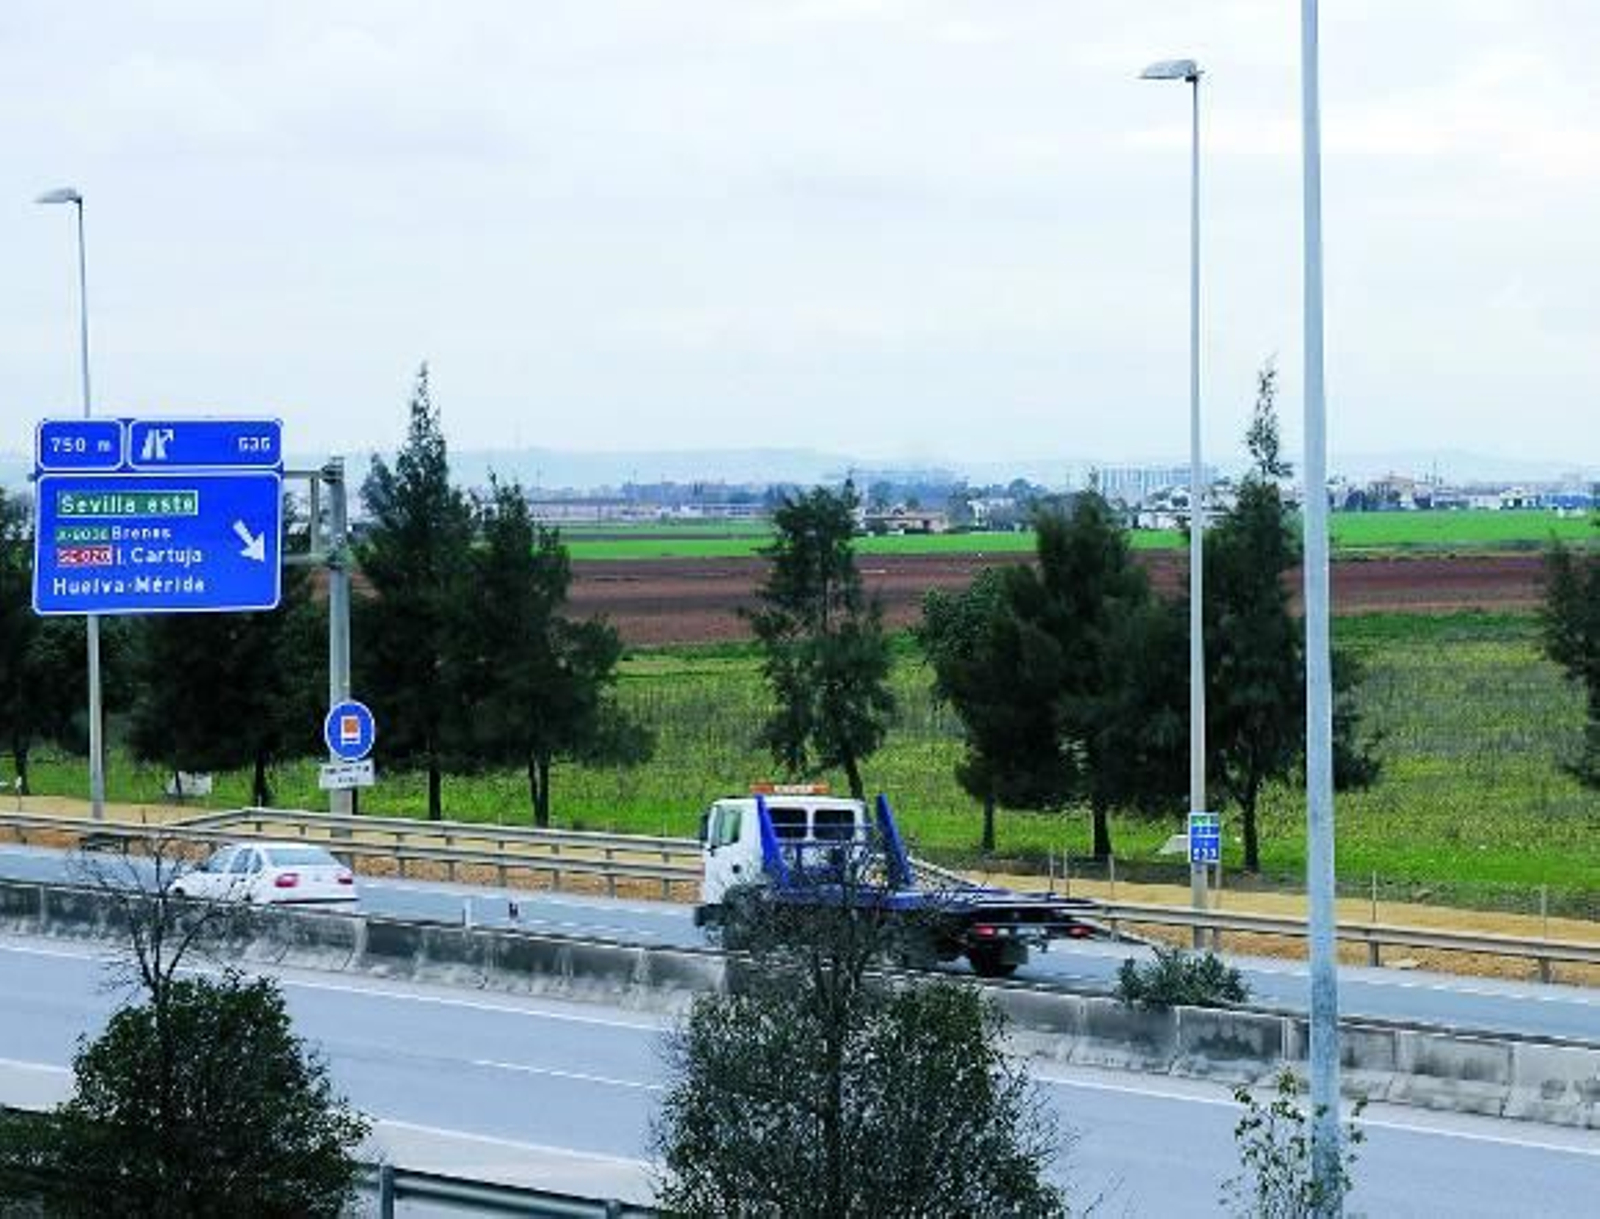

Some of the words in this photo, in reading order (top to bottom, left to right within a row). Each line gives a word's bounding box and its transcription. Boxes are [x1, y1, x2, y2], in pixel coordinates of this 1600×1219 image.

[51, 437, 86, 453] 750
[97, 440, 111, 452] m
[61, 494, 136, 513] Sevilla
[147, 495, 193, 512] este
[111, 526, 172, 541] Brenes
[131, 547, 202, 568] Cartuja
